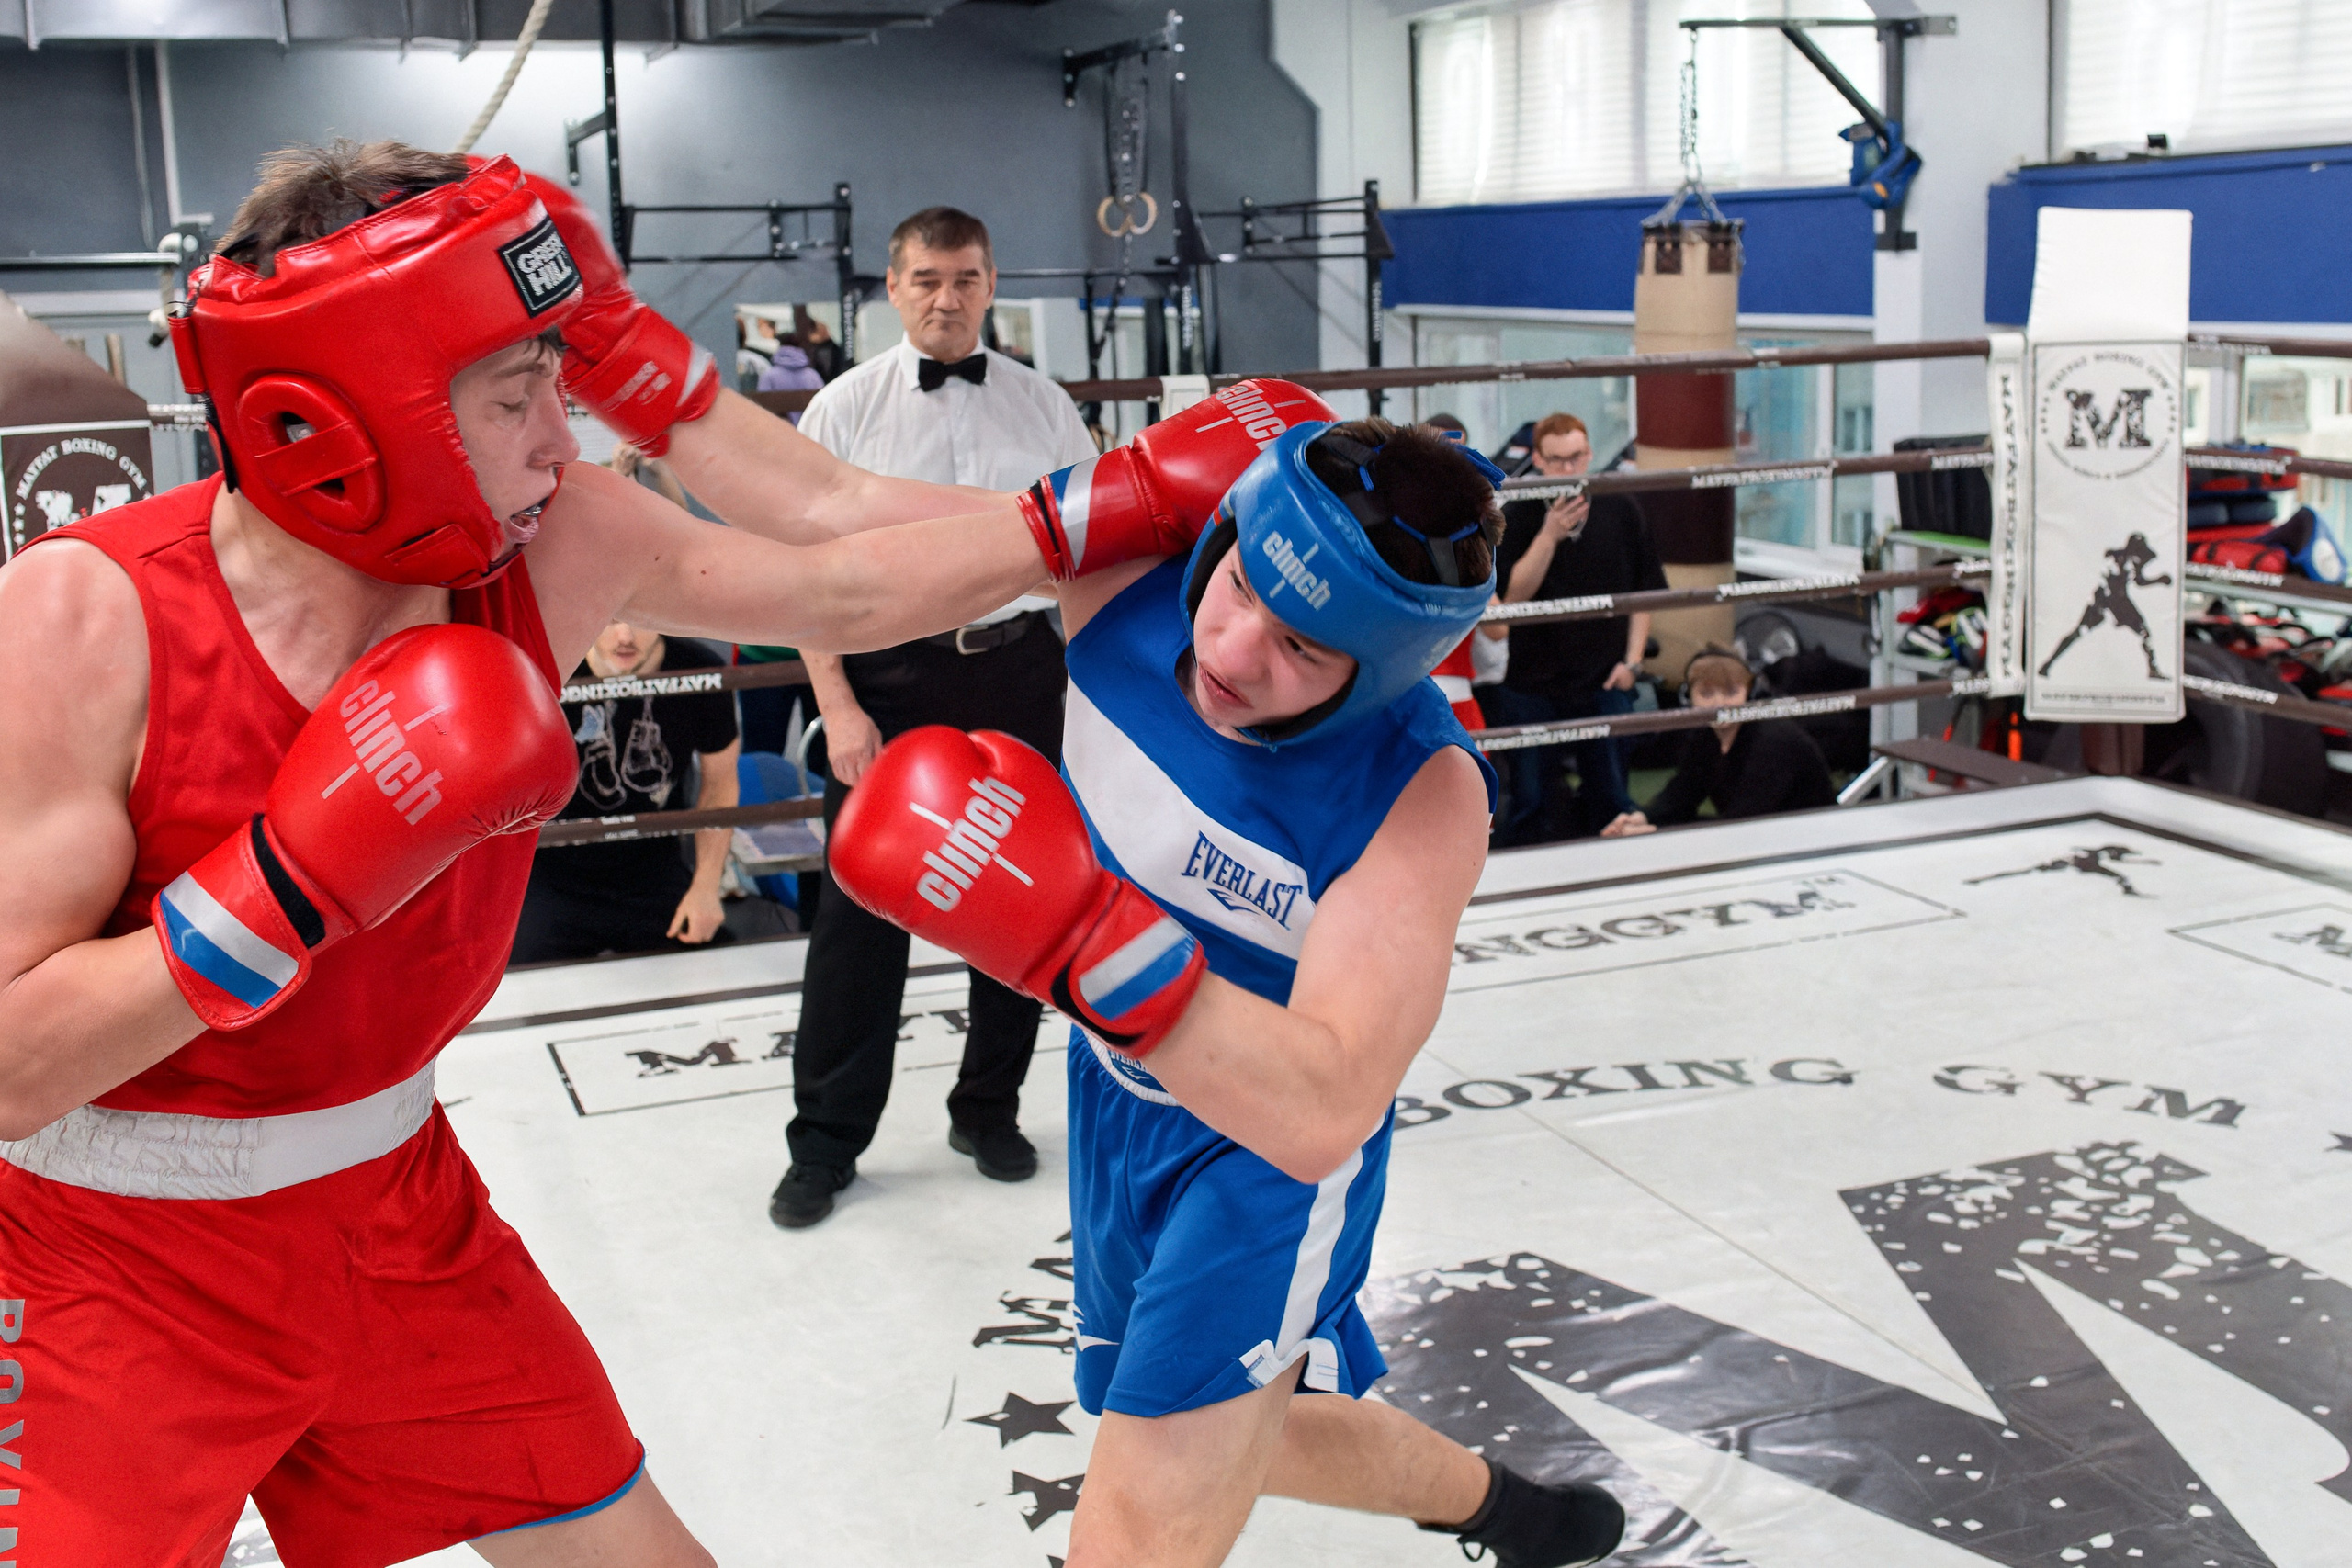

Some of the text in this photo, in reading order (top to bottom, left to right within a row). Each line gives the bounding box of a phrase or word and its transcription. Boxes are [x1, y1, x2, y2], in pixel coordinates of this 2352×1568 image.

[2064, 388, 2152, 450] M
[61, 437, 118, 461] BOXING
[119, 455, 147, 491] GYM
[1262, 530, 1331, 611] clinch
[340, 679, 445, 826] clinch
[916, 776, 1026, 912] clinch
[1180, 829, 1303, 931] EVERLAST
[1394, 1056, 2248, 1131] BOXING GYM
